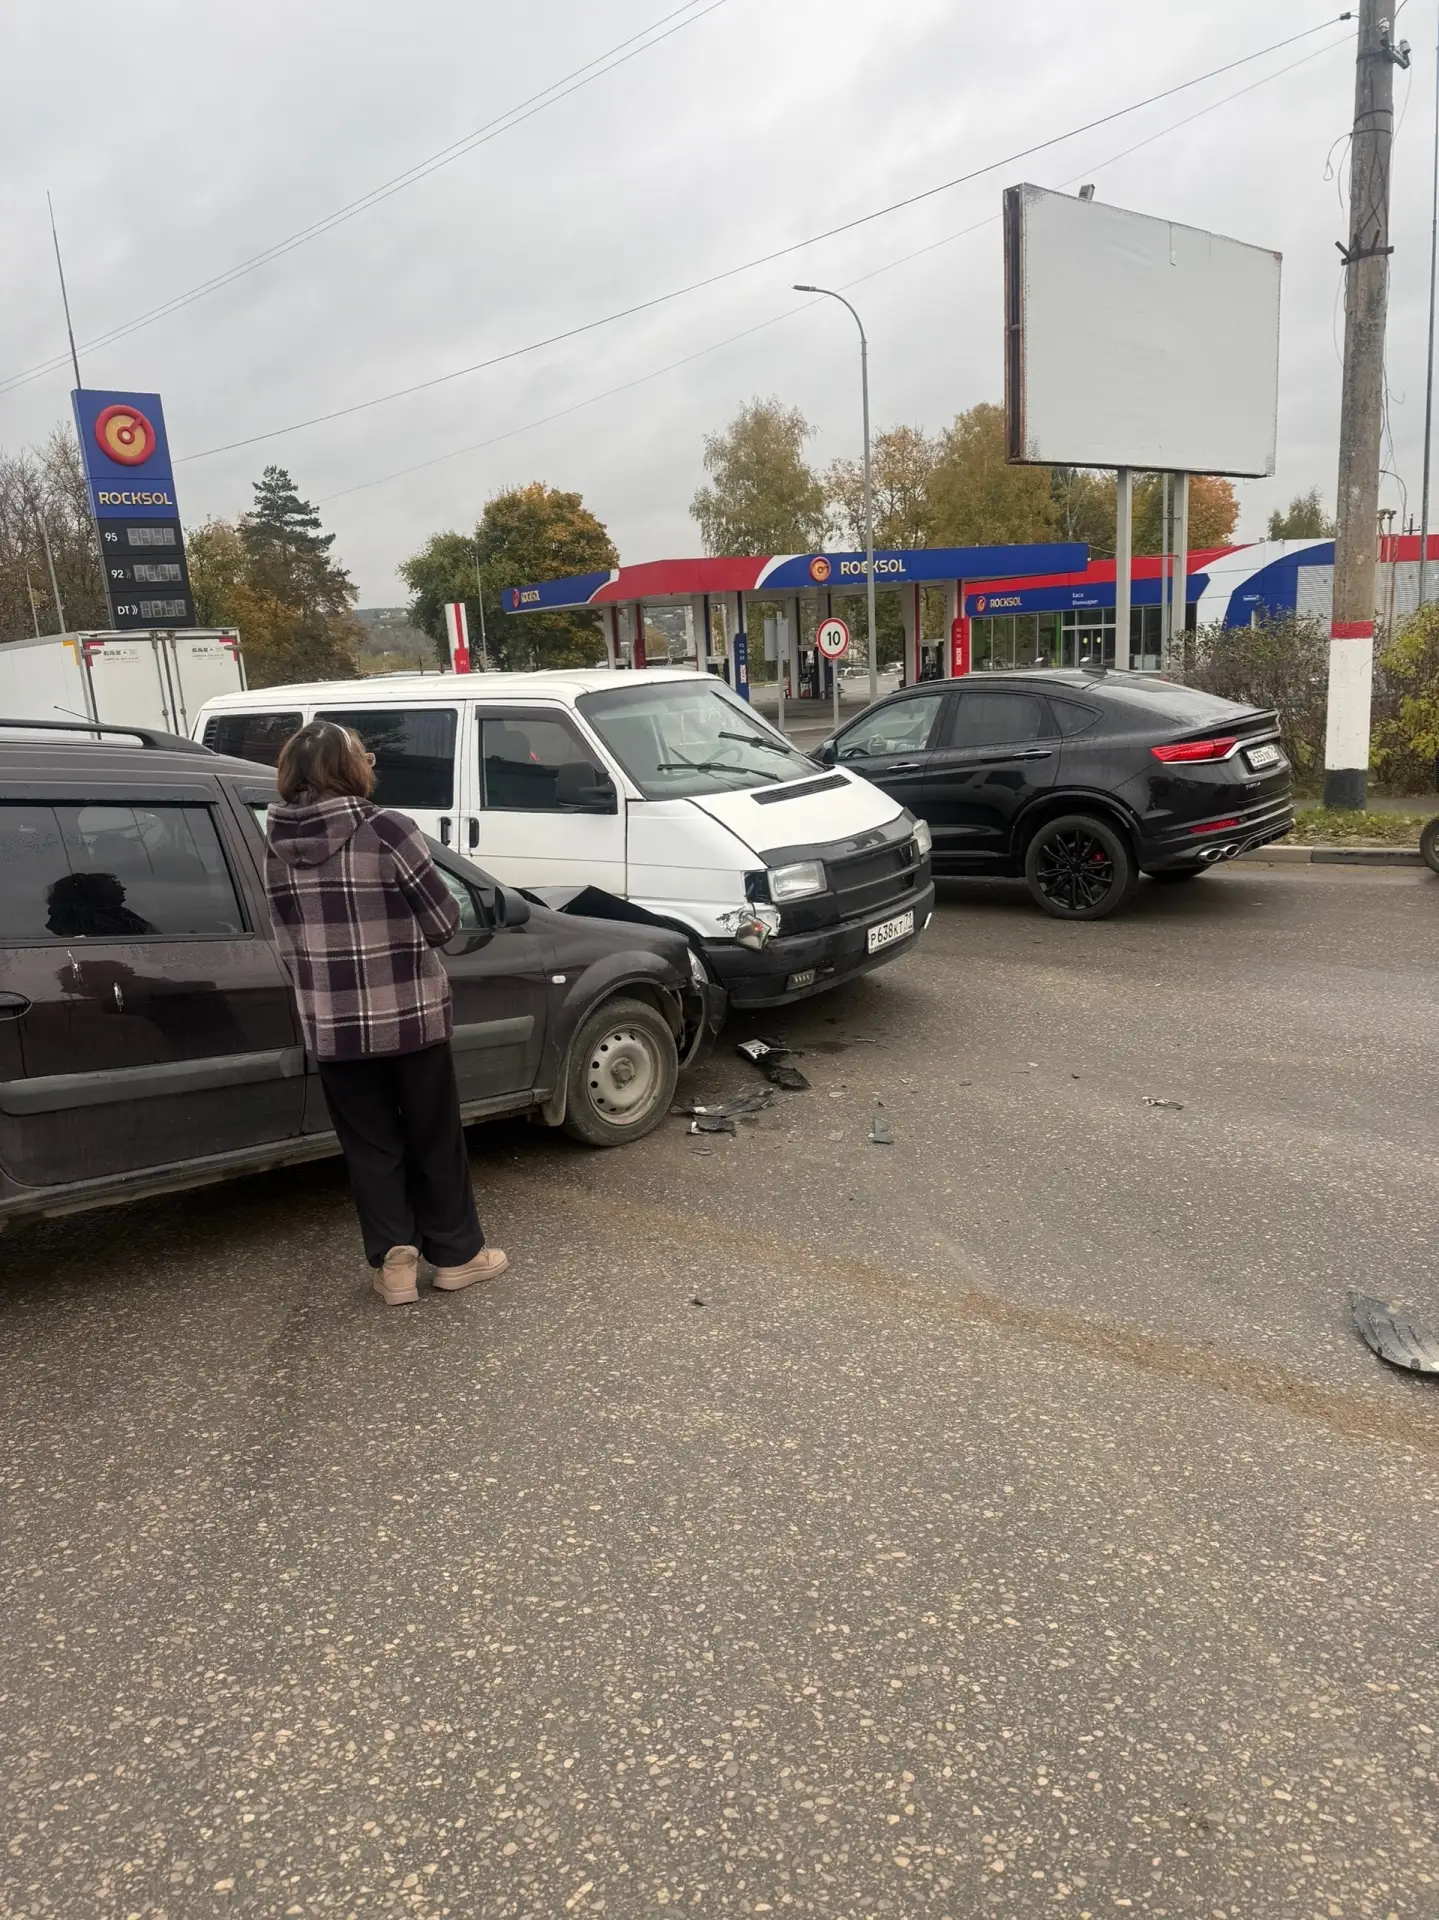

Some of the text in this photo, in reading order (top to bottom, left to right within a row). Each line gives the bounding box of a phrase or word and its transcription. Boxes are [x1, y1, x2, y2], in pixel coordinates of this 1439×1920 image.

[98, 491, 173, 505] ROCKSOL
[104, 532, 118, 542] 95
[111, 569, 125, 579] 92
[990, 597, 1023, 608] ROCKSOL
[117, 606, 130, 615] DT
[826, 631, 841, 647] 10
